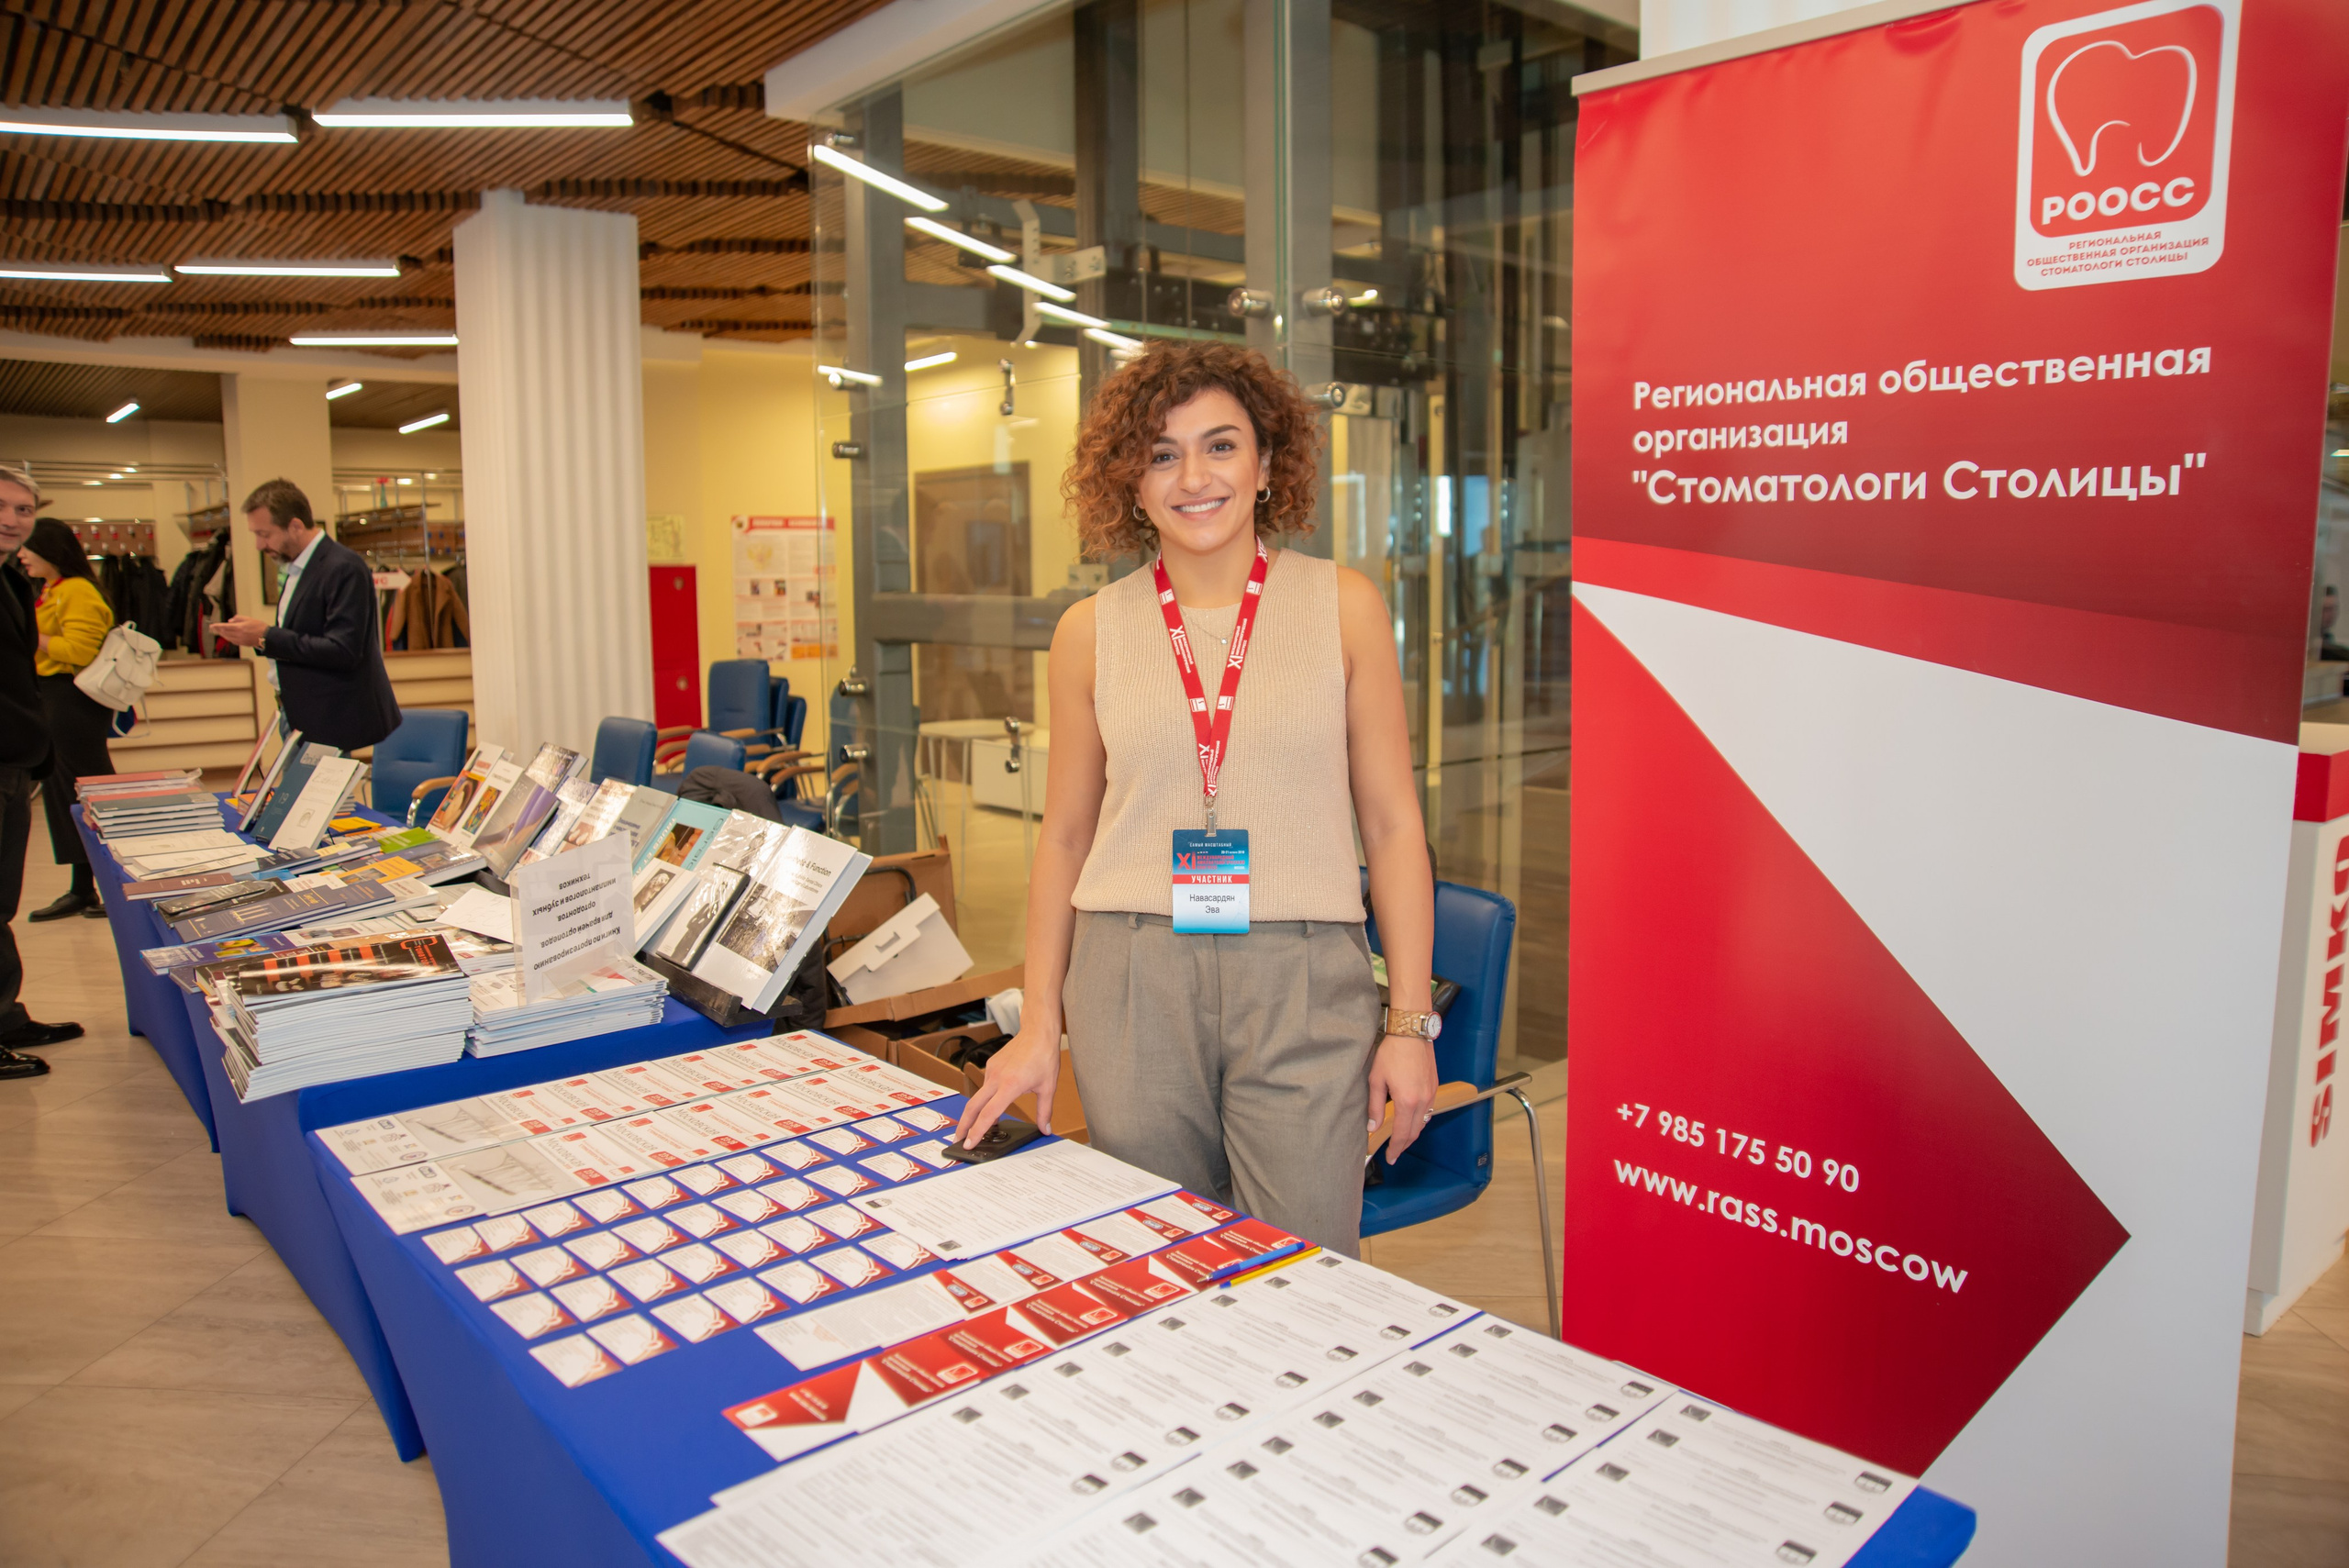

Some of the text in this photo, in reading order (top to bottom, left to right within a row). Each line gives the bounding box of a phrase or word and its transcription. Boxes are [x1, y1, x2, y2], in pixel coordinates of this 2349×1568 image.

[2042, 177, 2195, 226] РООСС
[2027, 237, 2210, 267] ОБЩЕСТВЕННАЯ ОРГАНИЗАЦИЯ
[2069, 231, 2162, 250] РЕГИОНАЛЬНАЯ
[2041, 252, 2188, 276] СТОМАТОЛОГИ СТОЛИЦЫ
[1633, 346, 2211, 410] Региональная общественная
[1632, 420, 1848, 459] организация
[1632, 452, 2207, 505] "Стоматологи Столицы"
[1176, 851, 1197, 870] XI
[558, 873, 591, 891] техников
[564, 877, 617, 906] имплантологов
[1191, 875, 1232, 884] УЧАСТНИК
[531, 899, 560, 917] зубных
[1189, 894, 1235, 903] Навасардян
[1205, 906, 1220, 914] Эва
[577, 917, 601, 933] врачей
[601, 926, 621, 940] Книги
[533, 939, 593, 971] протезированию
[1617, 1103, 1859, 1193] +7 985 175 50 90
[1614, 1159, 1968, 1294] www.rass.moscow
